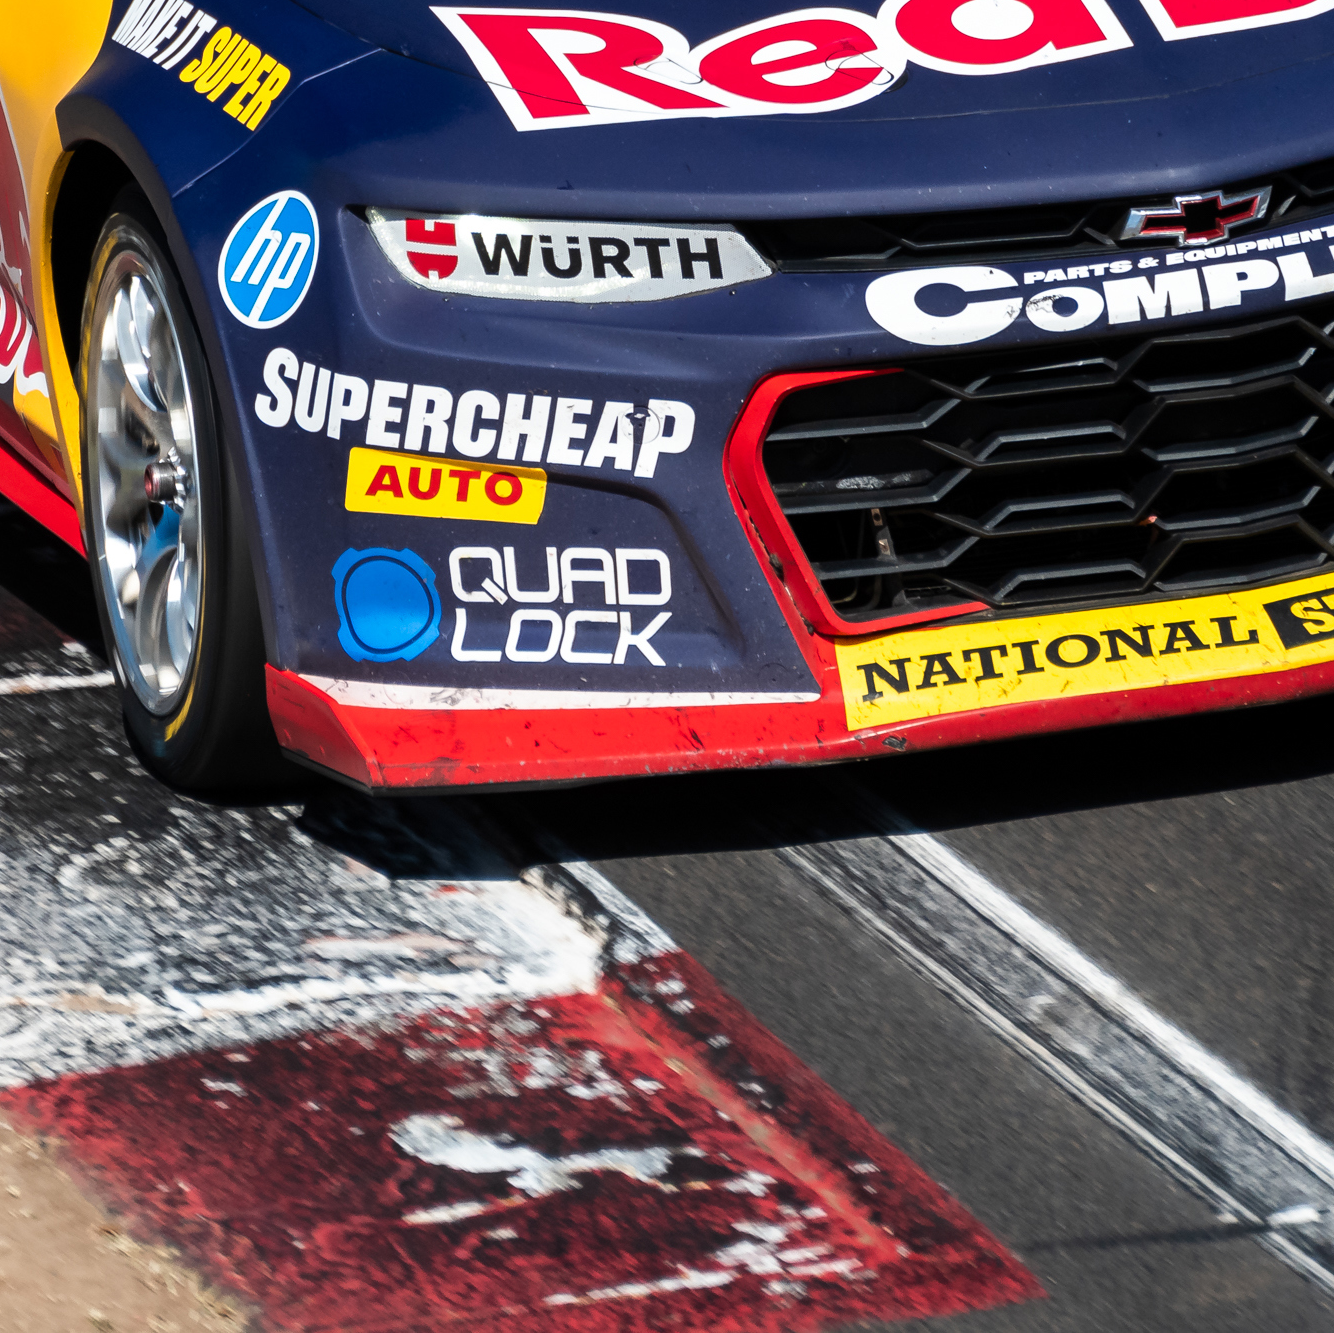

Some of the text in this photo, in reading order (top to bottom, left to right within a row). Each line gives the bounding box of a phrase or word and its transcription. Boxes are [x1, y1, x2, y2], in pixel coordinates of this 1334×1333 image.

[152, 9, 218, 70] IT
[179, 26, 291, 132] SUPER
[229, 193, 310, 322] hp
[471, 231, 723, 280] WÜRTH
[1023, 260, 1133, 285] PARTS
[1138, 257, 1159, 269] &
[255, 347, 696, 478] SUPERCHEAP
[366, 463, 524, 507] AUTO
[450, 547, 671, 605] QUAD
[450, 609, 671, 666] LOCK
[857, 614, 1261, 702] NATIONAL
